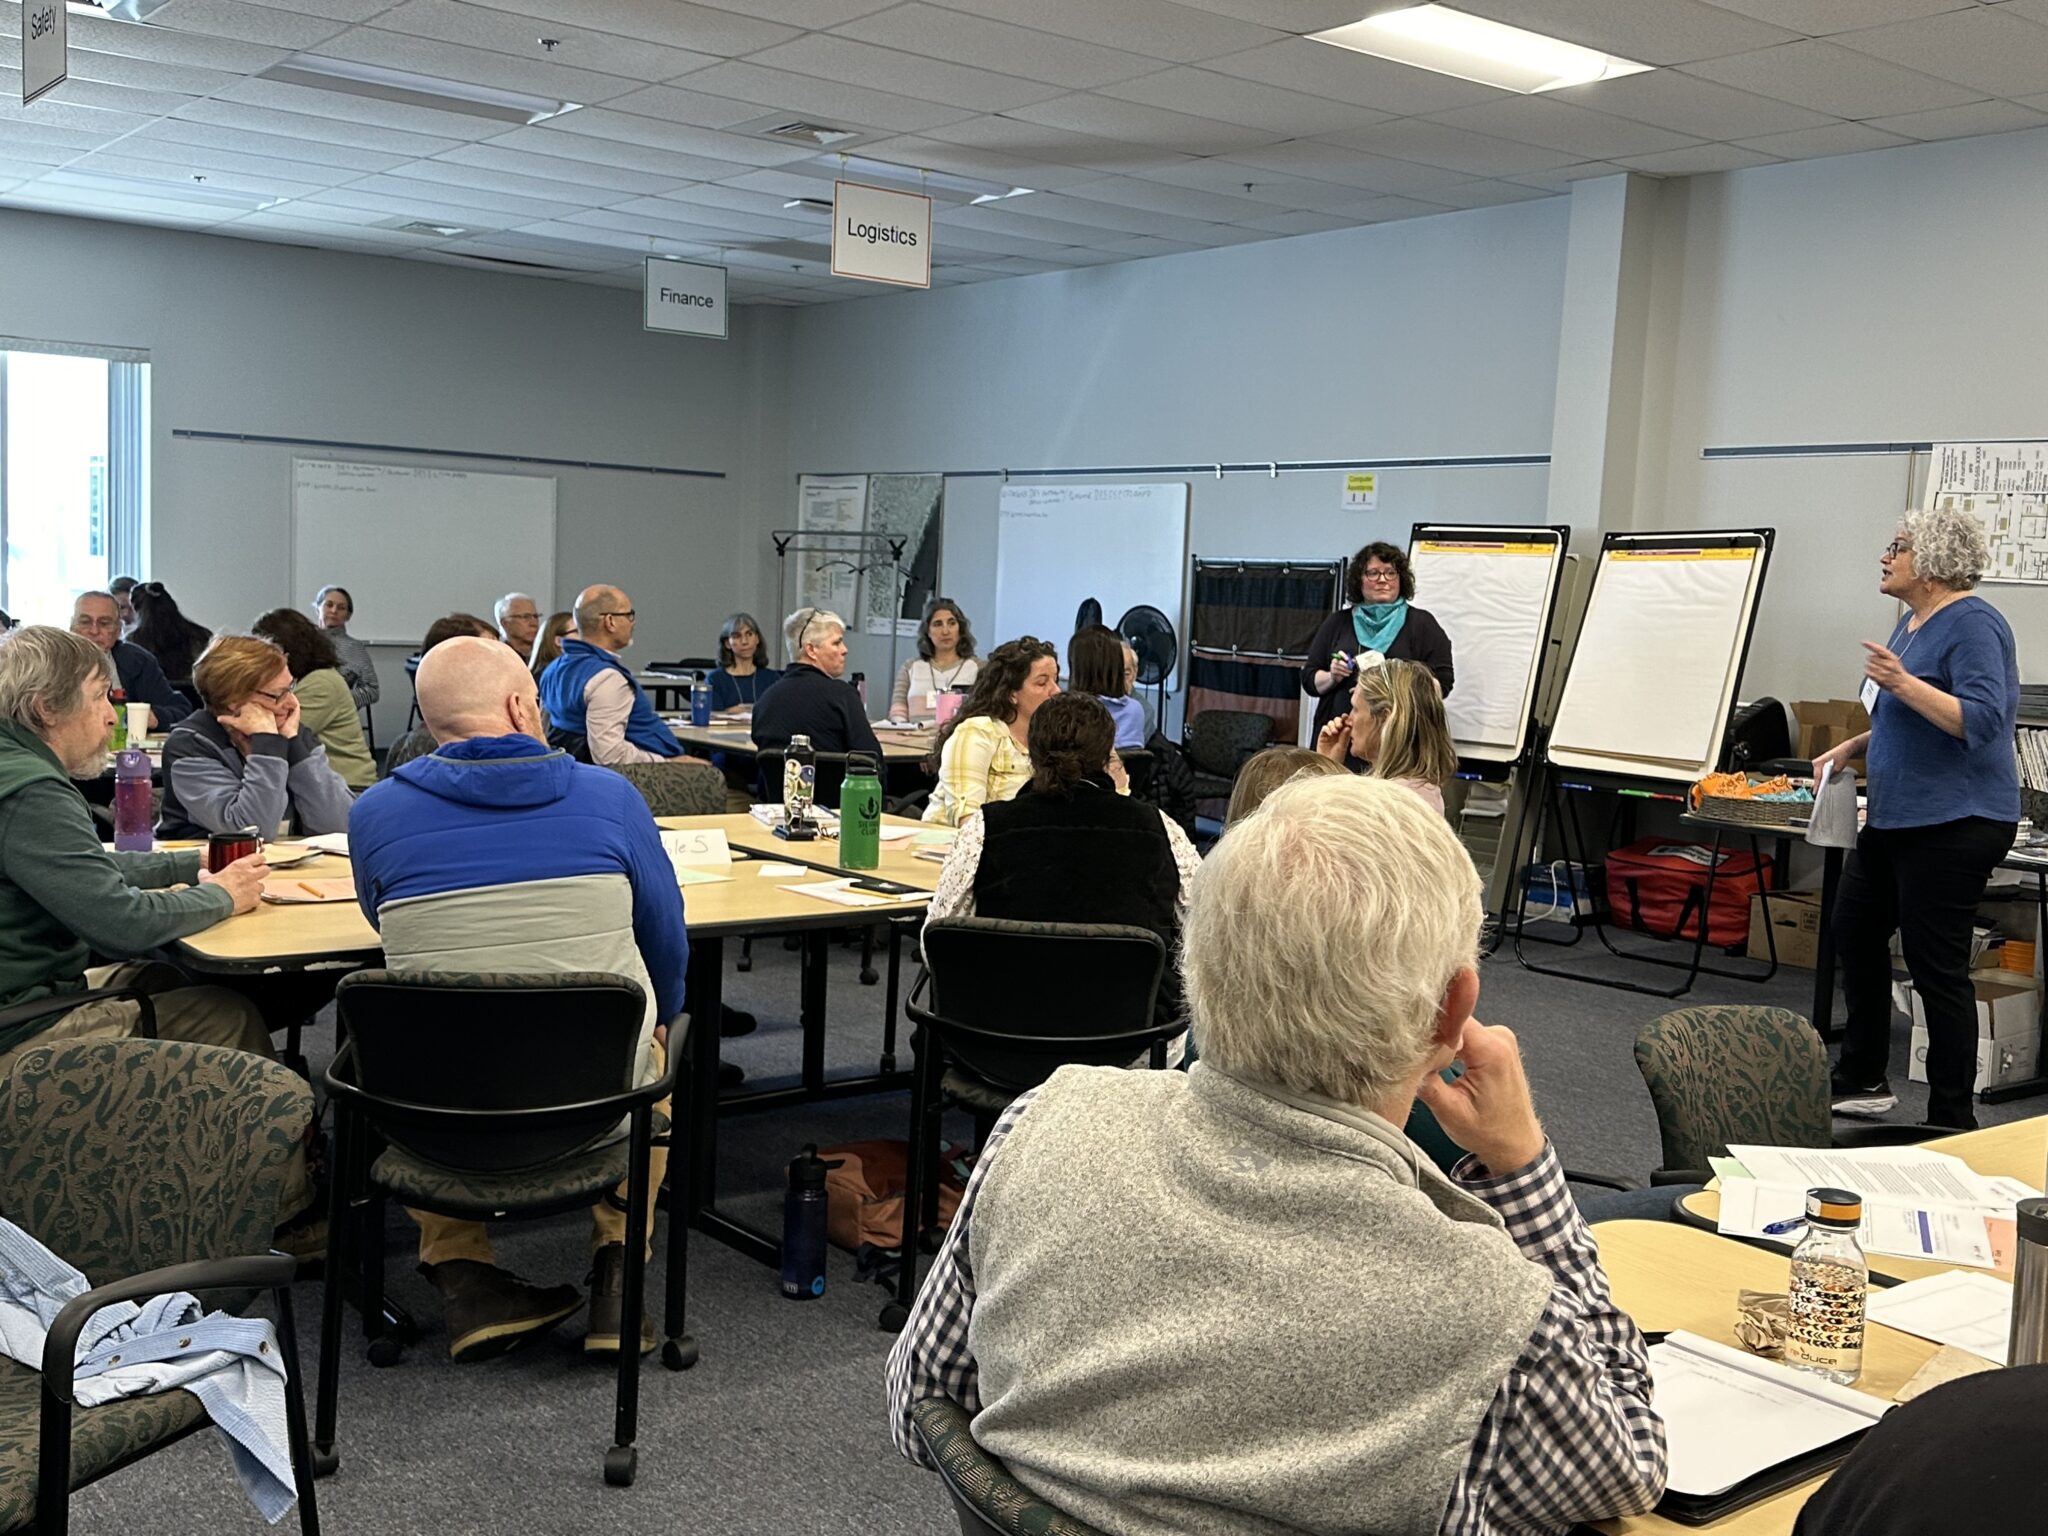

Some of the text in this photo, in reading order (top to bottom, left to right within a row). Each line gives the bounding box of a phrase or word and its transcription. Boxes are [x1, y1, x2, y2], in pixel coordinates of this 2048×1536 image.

[31, 5, 57, 40] Safety
[847, 217, 918, 247] Logistics
[660, 287, 714, 309] Finance
